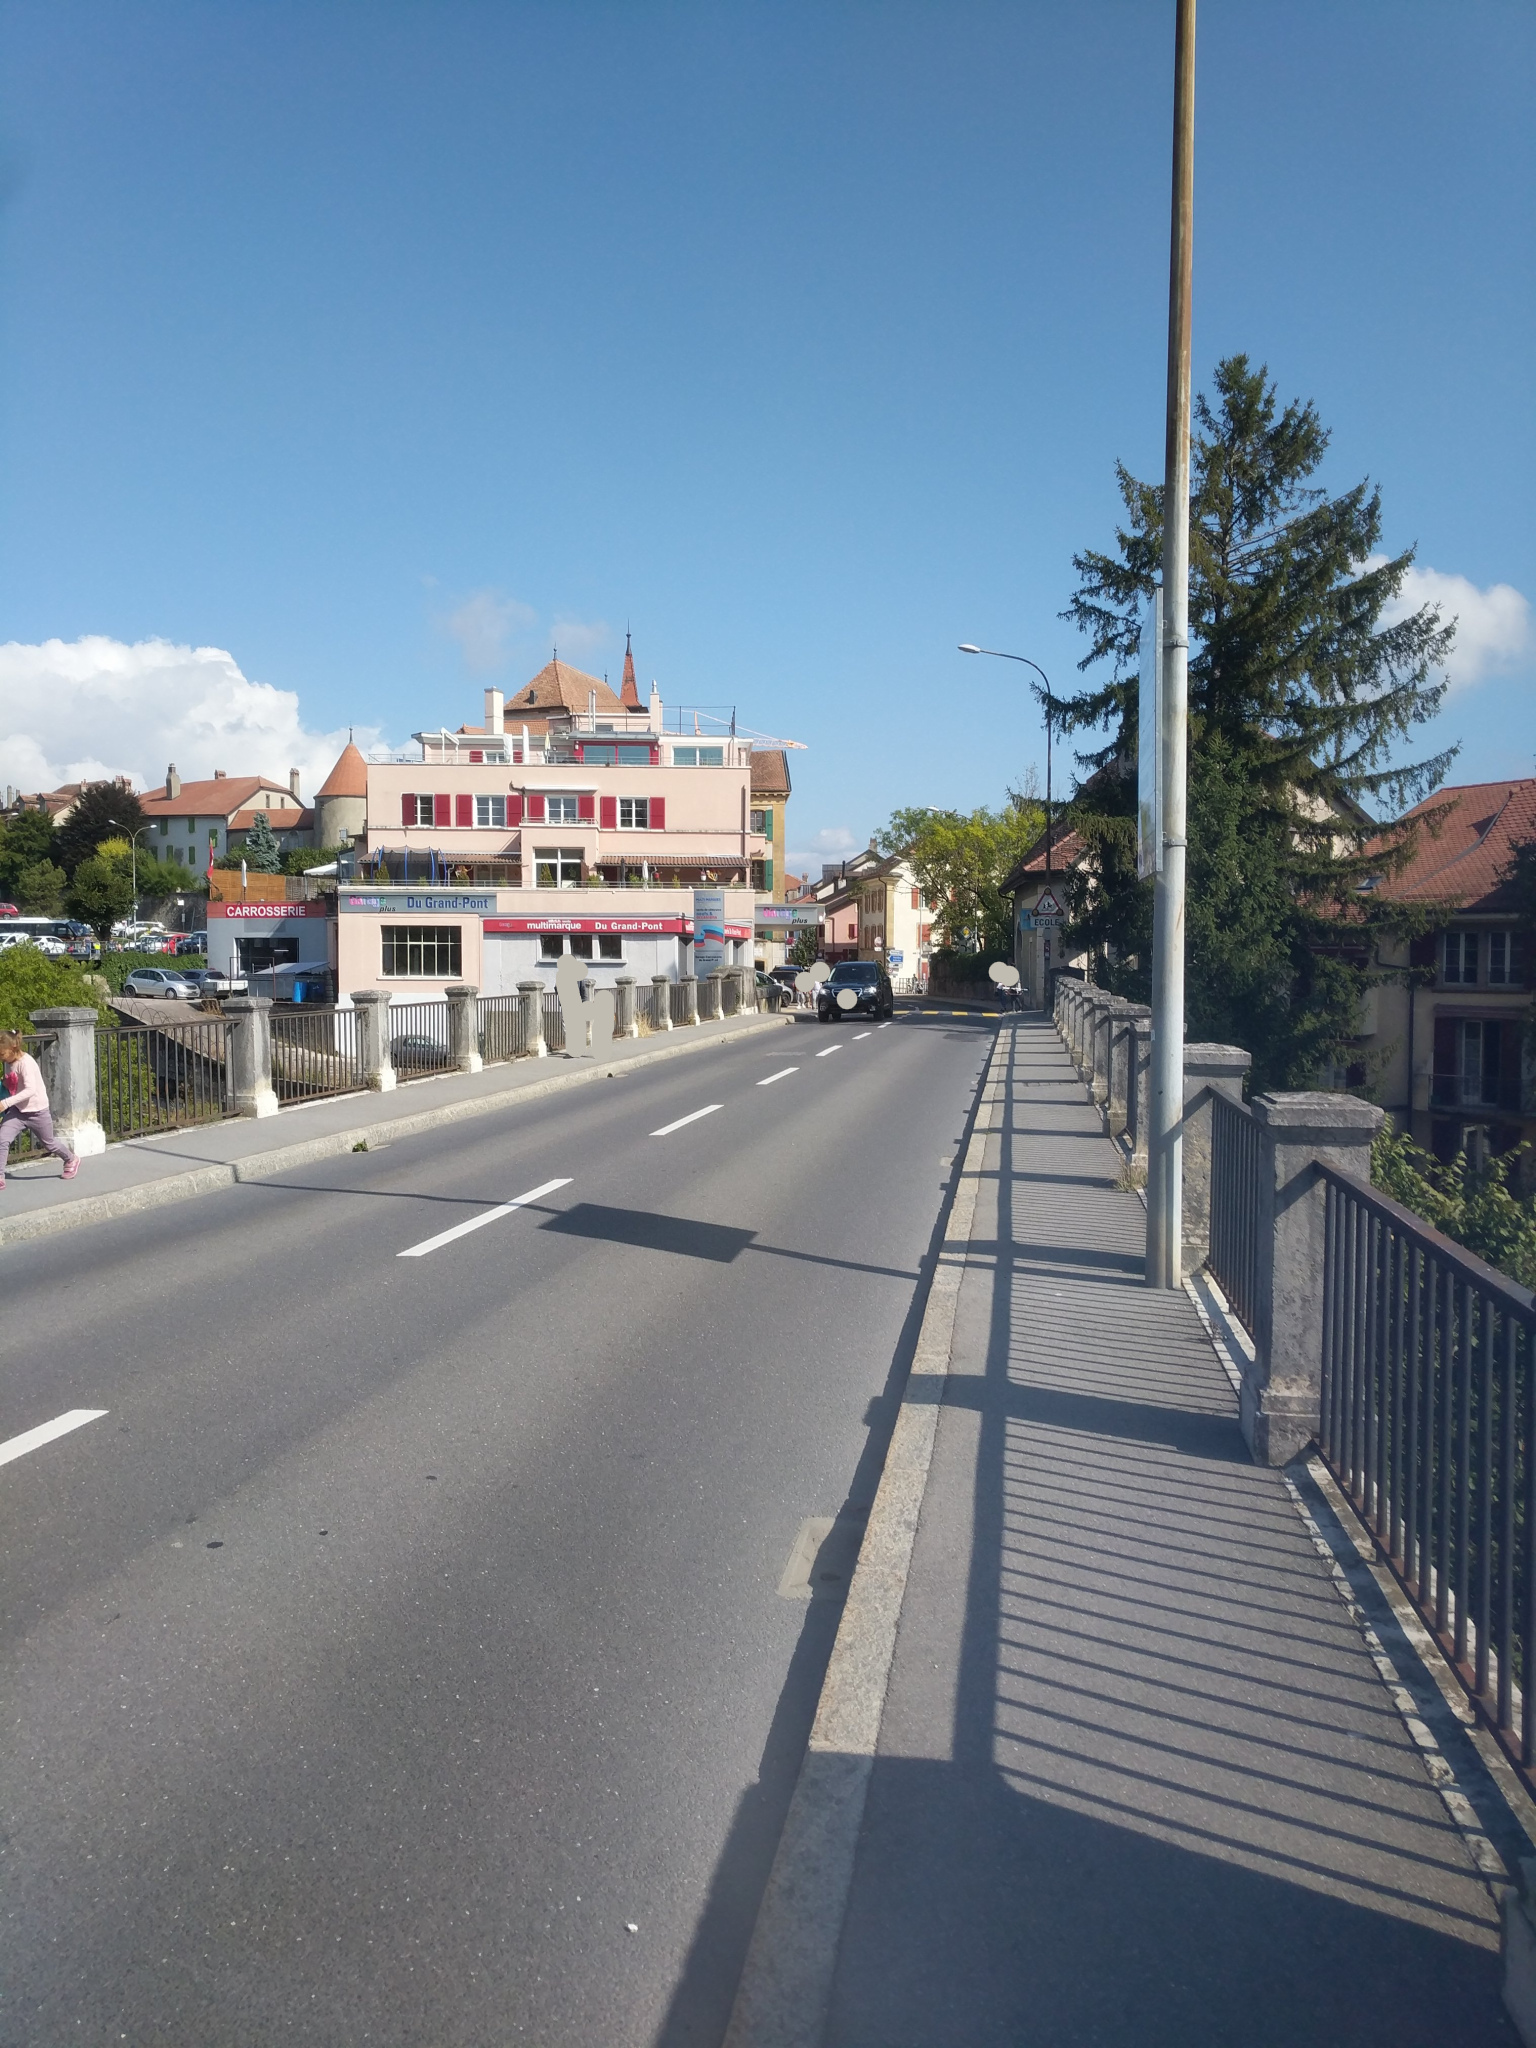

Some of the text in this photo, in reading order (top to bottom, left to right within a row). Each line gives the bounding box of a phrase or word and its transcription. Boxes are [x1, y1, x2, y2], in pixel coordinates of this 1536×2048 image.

[407, 896, 488, 909] Du Grand-Pont
[226, 906, 306, 917] CARROSSERIE
[379, 905, 396, 913] plus
[526, 921, 582, 931] multimarque
[595, 922, 663, 930] Du Grand-Pont
[1034, 918, 1060, 927] ECOLE
